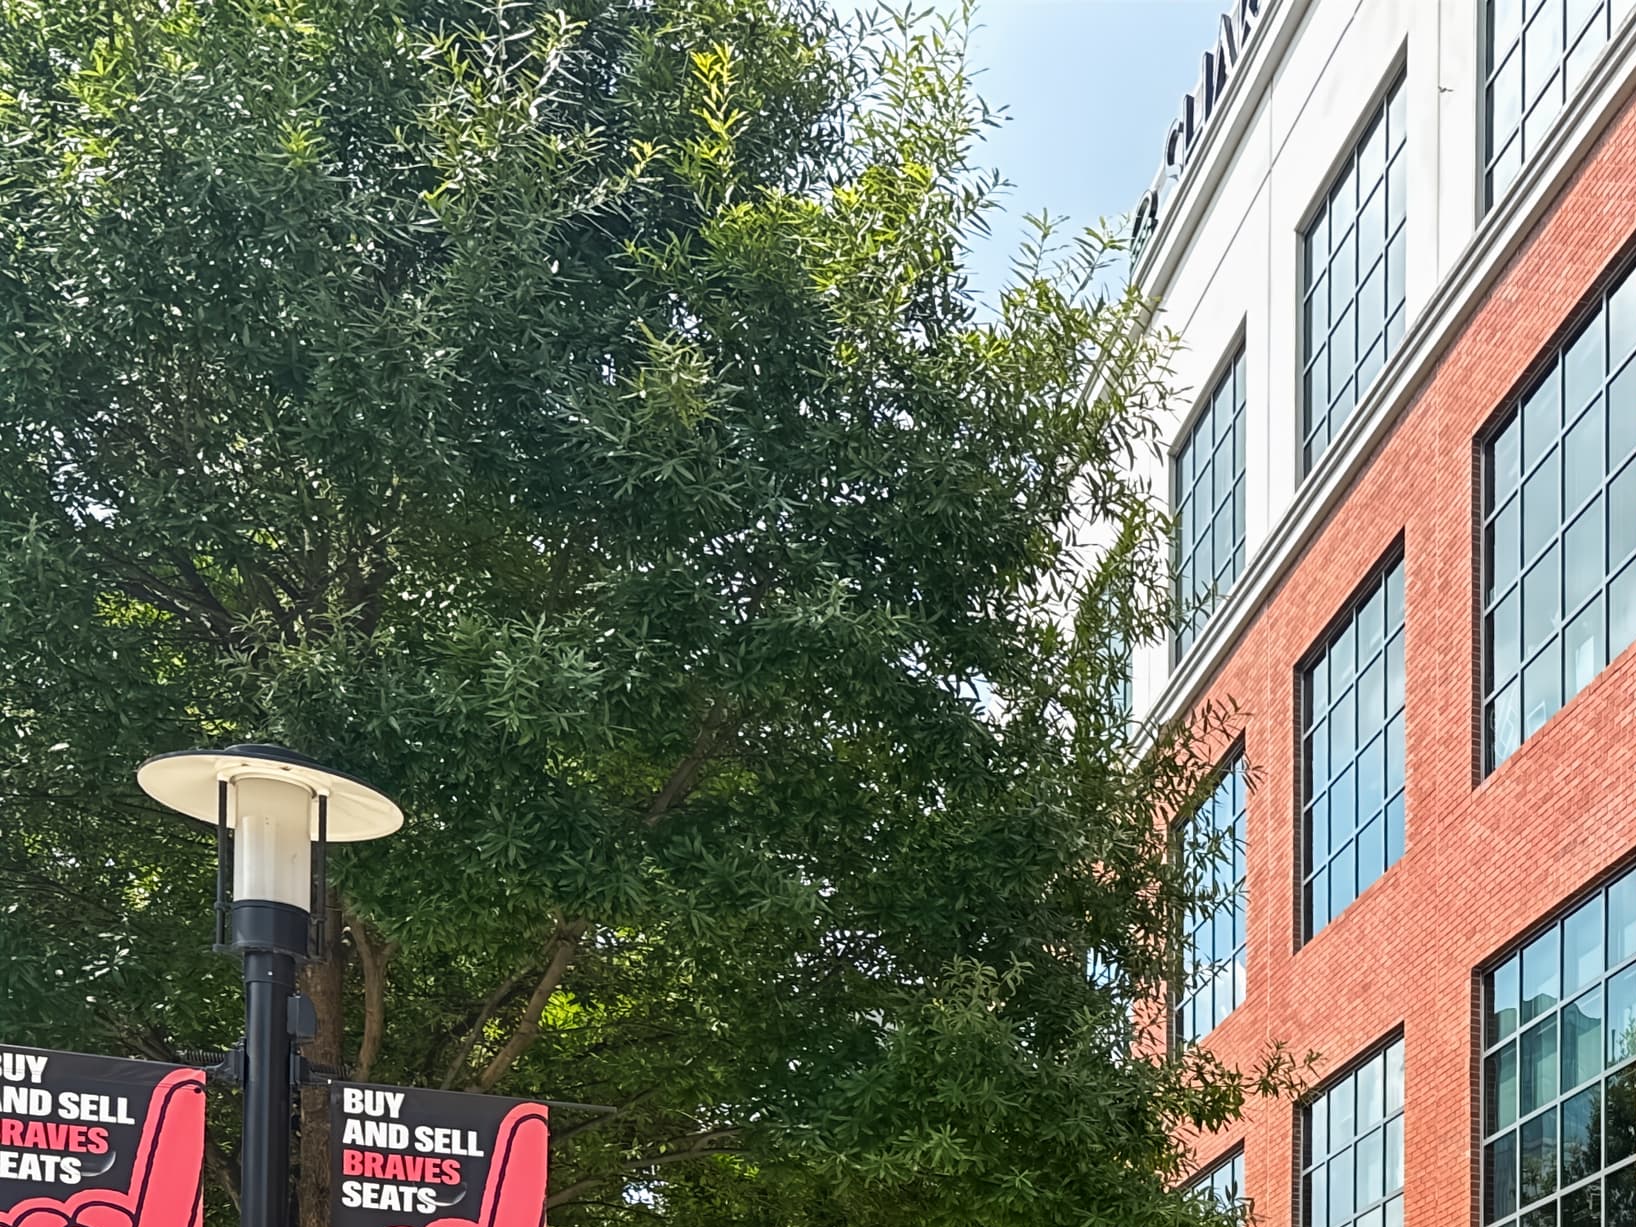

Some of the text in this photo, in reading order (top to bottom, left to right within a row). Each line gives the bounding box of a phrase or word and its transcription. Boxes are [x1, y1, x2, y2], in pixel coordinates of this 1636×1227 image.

[0, 1053, 48, 1083] UY
[0, 1085, 135, 1125] ND SELL
[343, 1087, 405, 1119] BUY
[0, 1118, 108, 1154] RAVES
[342, 1118, 485, 1157] AND SELL
[0, 1150, 82, 1184] EATS
[343, 1149, 461, 1185] BRAVES
[342, 1180, 437, 1214] SEATS
